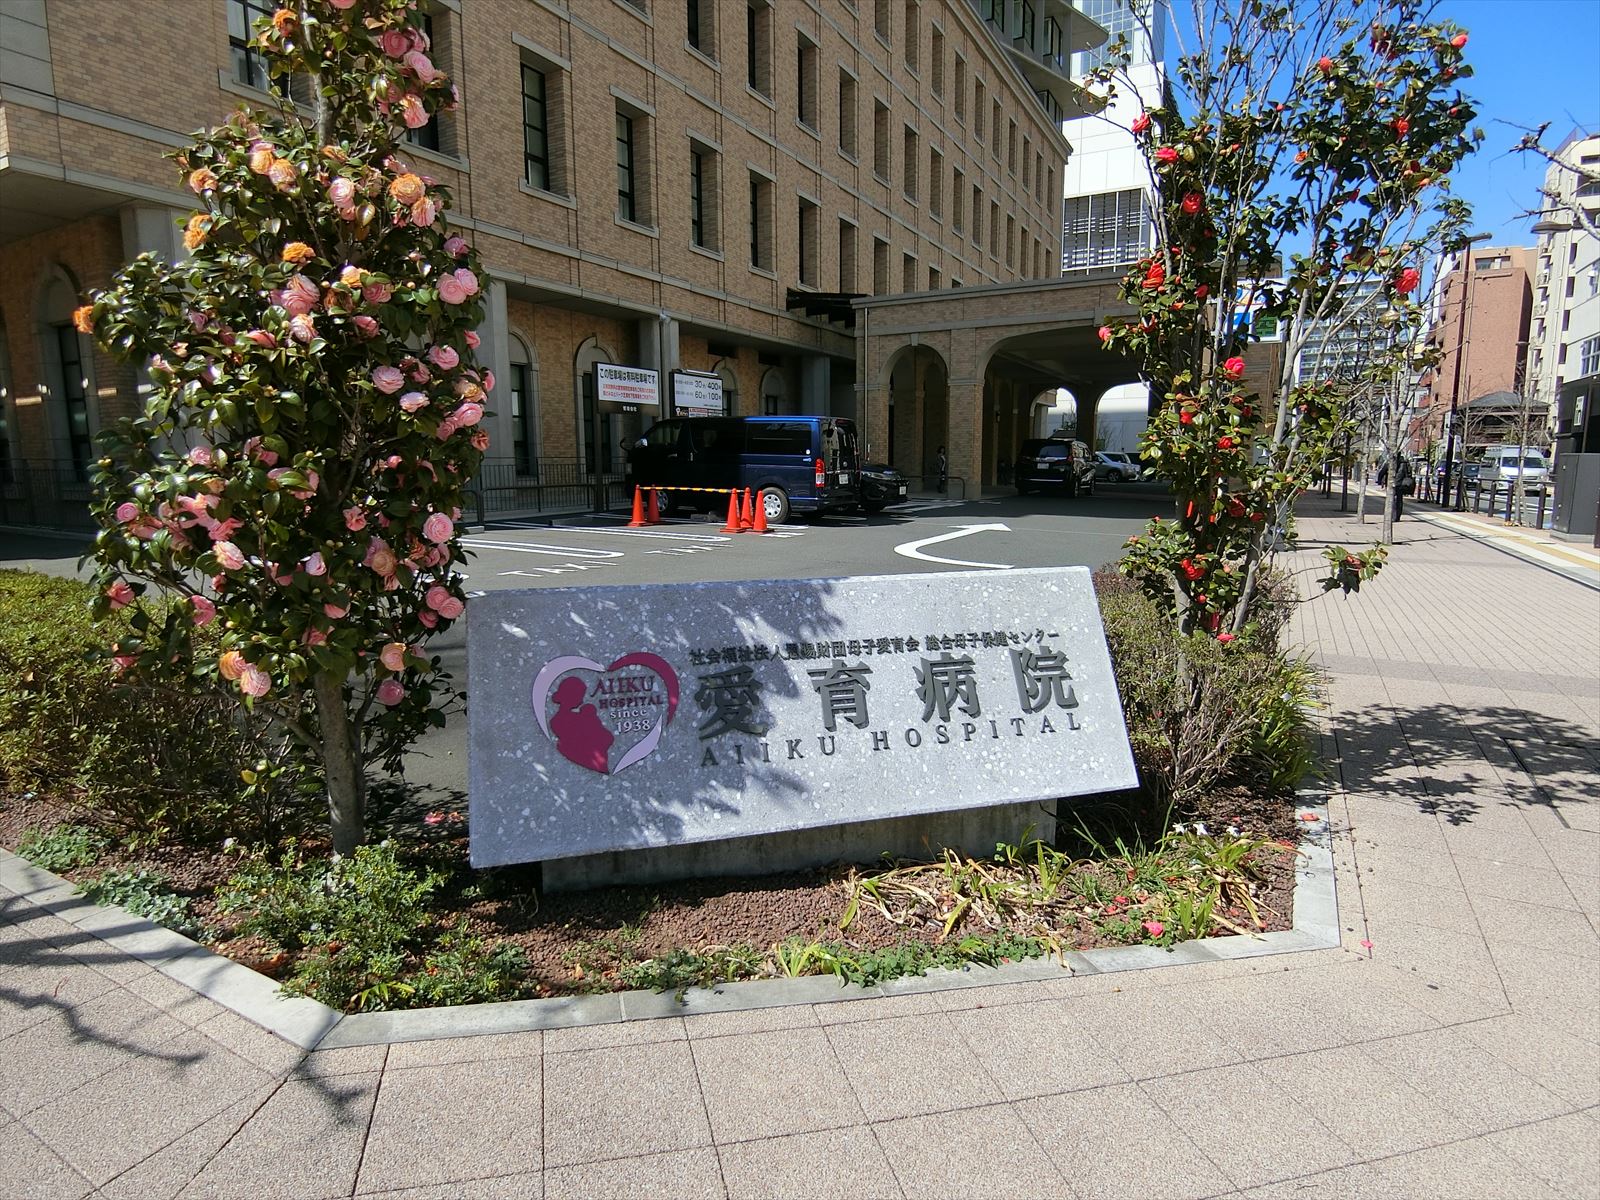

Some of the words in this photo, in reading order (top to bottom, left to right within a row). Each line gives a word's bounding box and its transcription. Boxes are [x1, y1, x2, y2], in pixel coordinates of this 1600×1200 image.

[496, 560, 619, 578] TAXI
[924, 628, 1060, 651] 総合母子保健センター
[590, 675, 655, 697] AIIKU
[694, 645, 1080, 741] 愛育病院
[599, 695, 664, 709] HOSPITAL
[609, 708, 648, 719] since
[616, 719, 651, 733] 1938
[700, 735, 836, 767] AIIKU
[871, 712, 1081, 751] HOSPITAL
